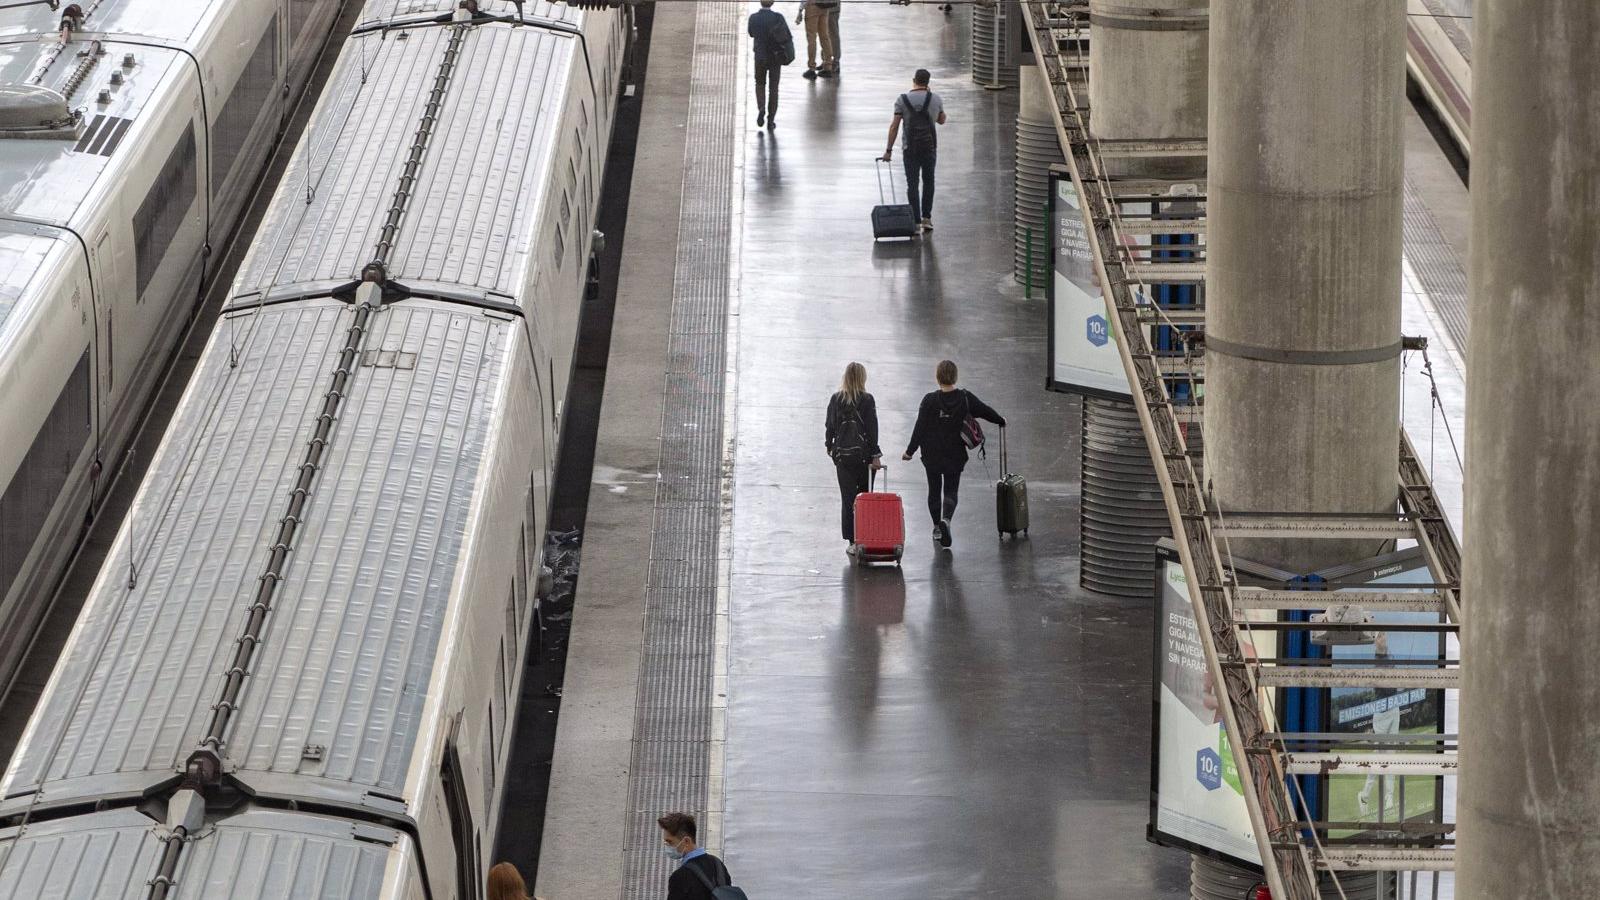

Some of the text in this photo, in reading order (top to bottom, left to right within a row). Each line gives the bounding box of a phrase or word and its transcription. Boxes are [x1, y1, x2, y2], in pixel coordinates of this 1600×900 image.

[1061, 218, 1086, 229] ESTREN
[1060, 247, 1071, 257] SIN
[1170, 570, 1186, 583] Lyca
[1169, 612, 1198, 630] ESTREN
[1169, 626, 1186, 640] GIGA
[1169, 639, 1175, 649] Y
[1168, 652, 1180, 664] SIN
[1339, 699, 1387, 723] EMISIONES
[1388, 693, 1409, 710] BAJO
[1410, 688, 1426, 704] PAR
